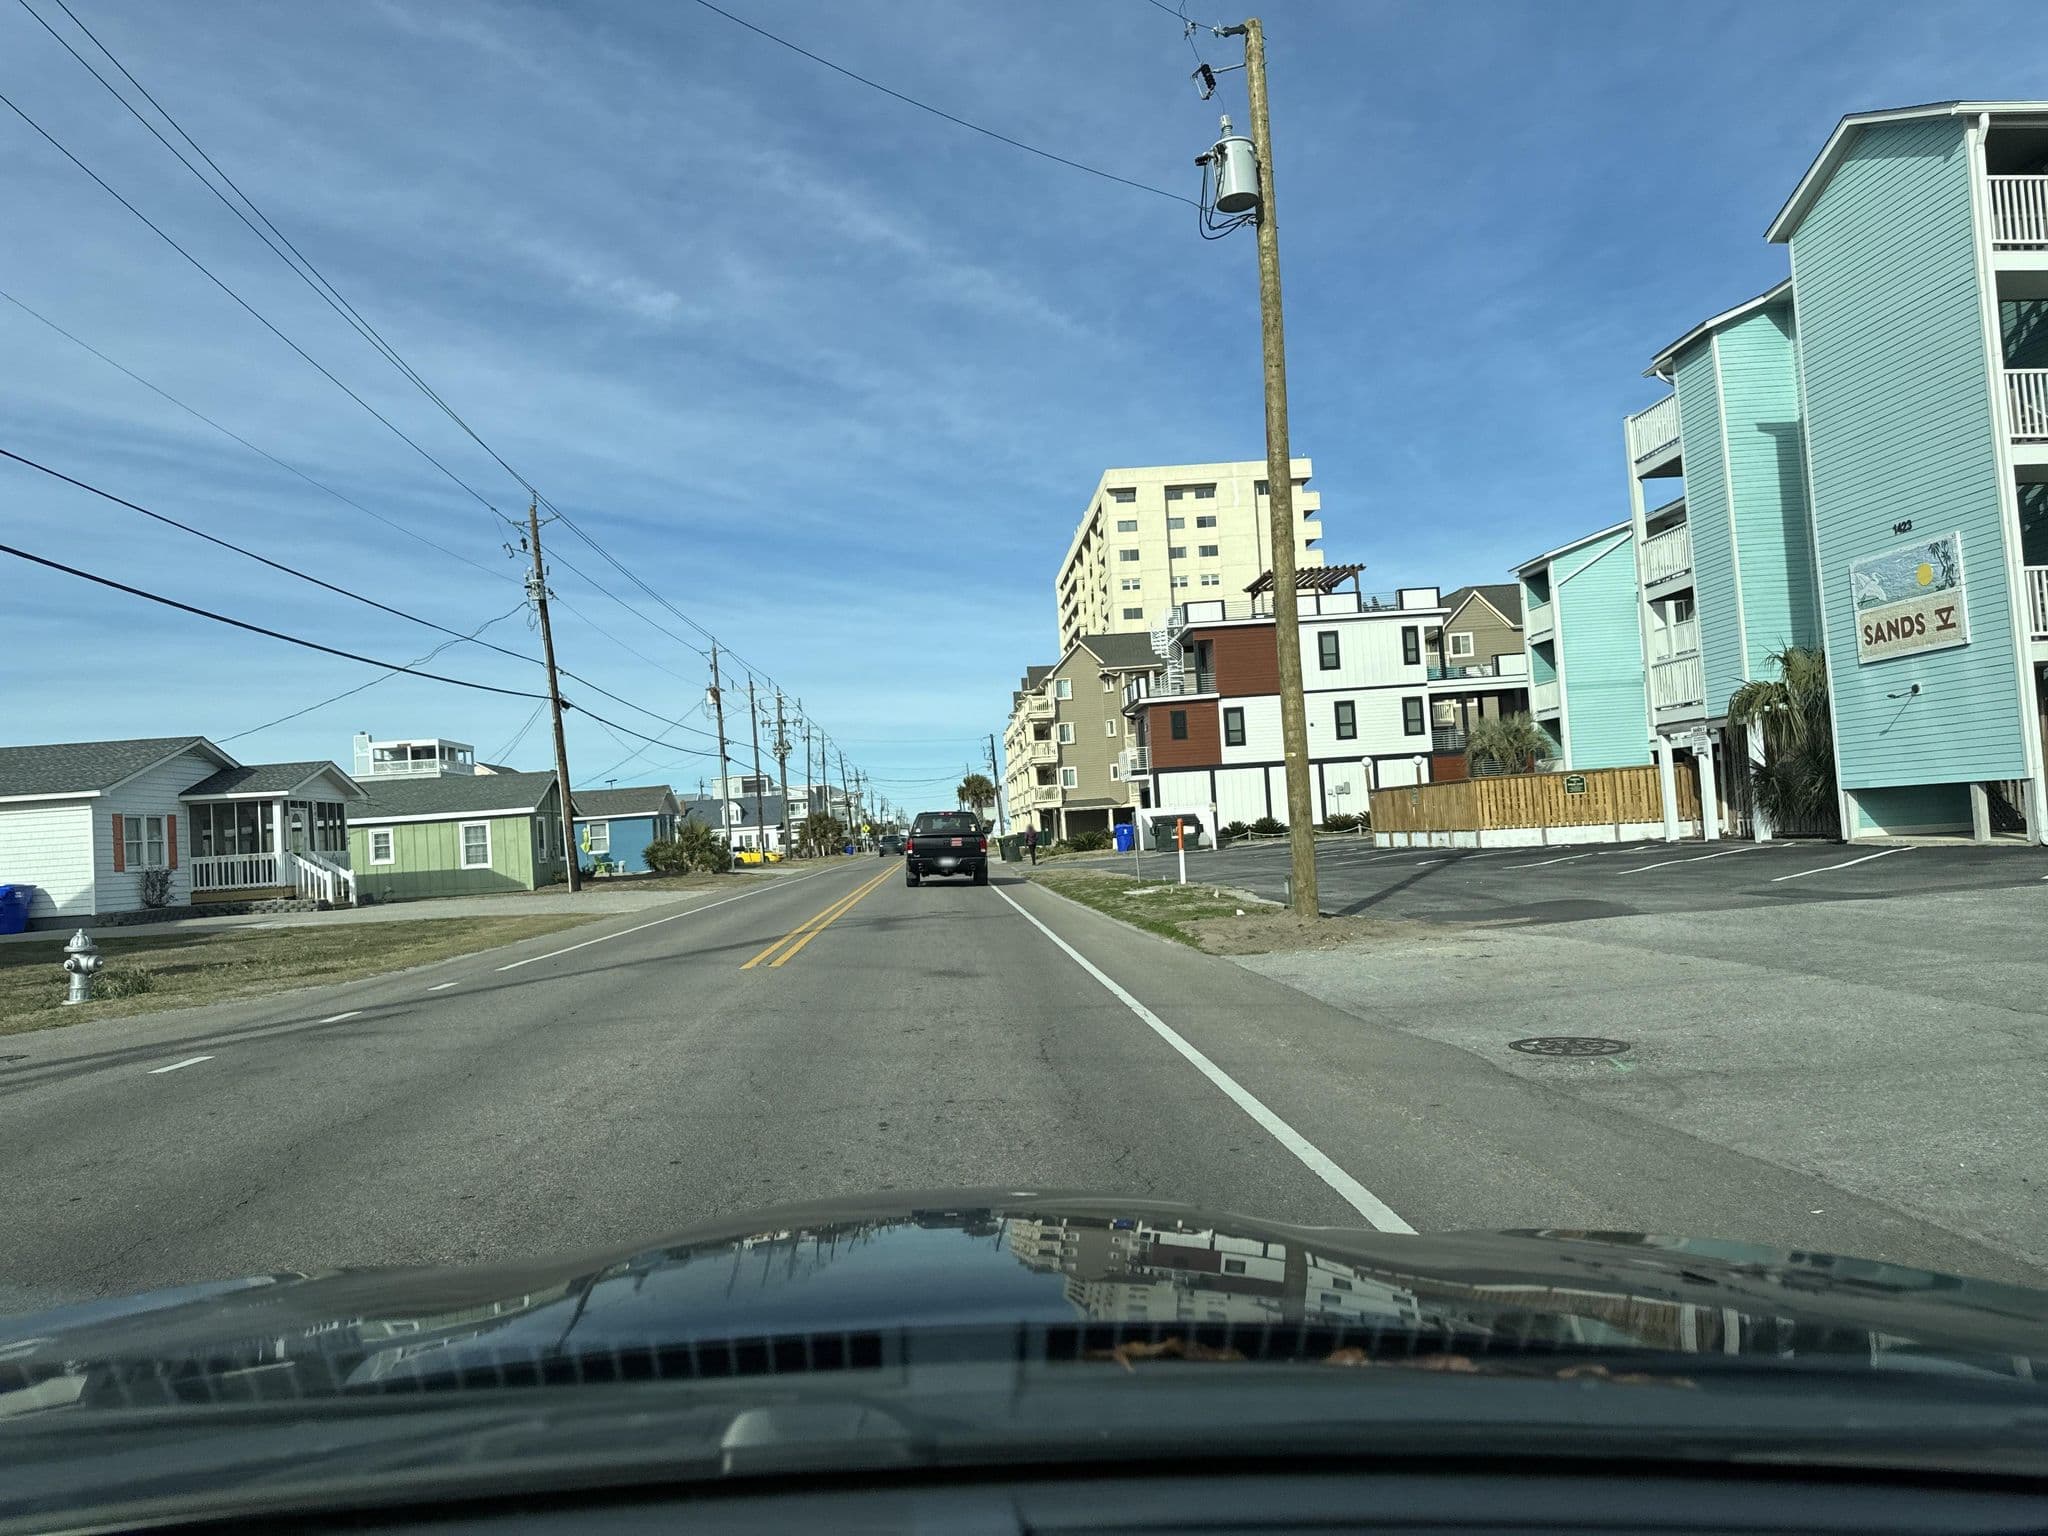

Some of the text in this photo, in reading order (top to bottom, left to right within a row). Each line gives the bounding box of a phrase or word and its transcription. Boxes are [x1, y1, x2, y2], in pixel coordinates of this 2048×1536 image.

[1892, 519, 1912, 534] 1423
[1863, 605, 1957, 646] SANDS V
